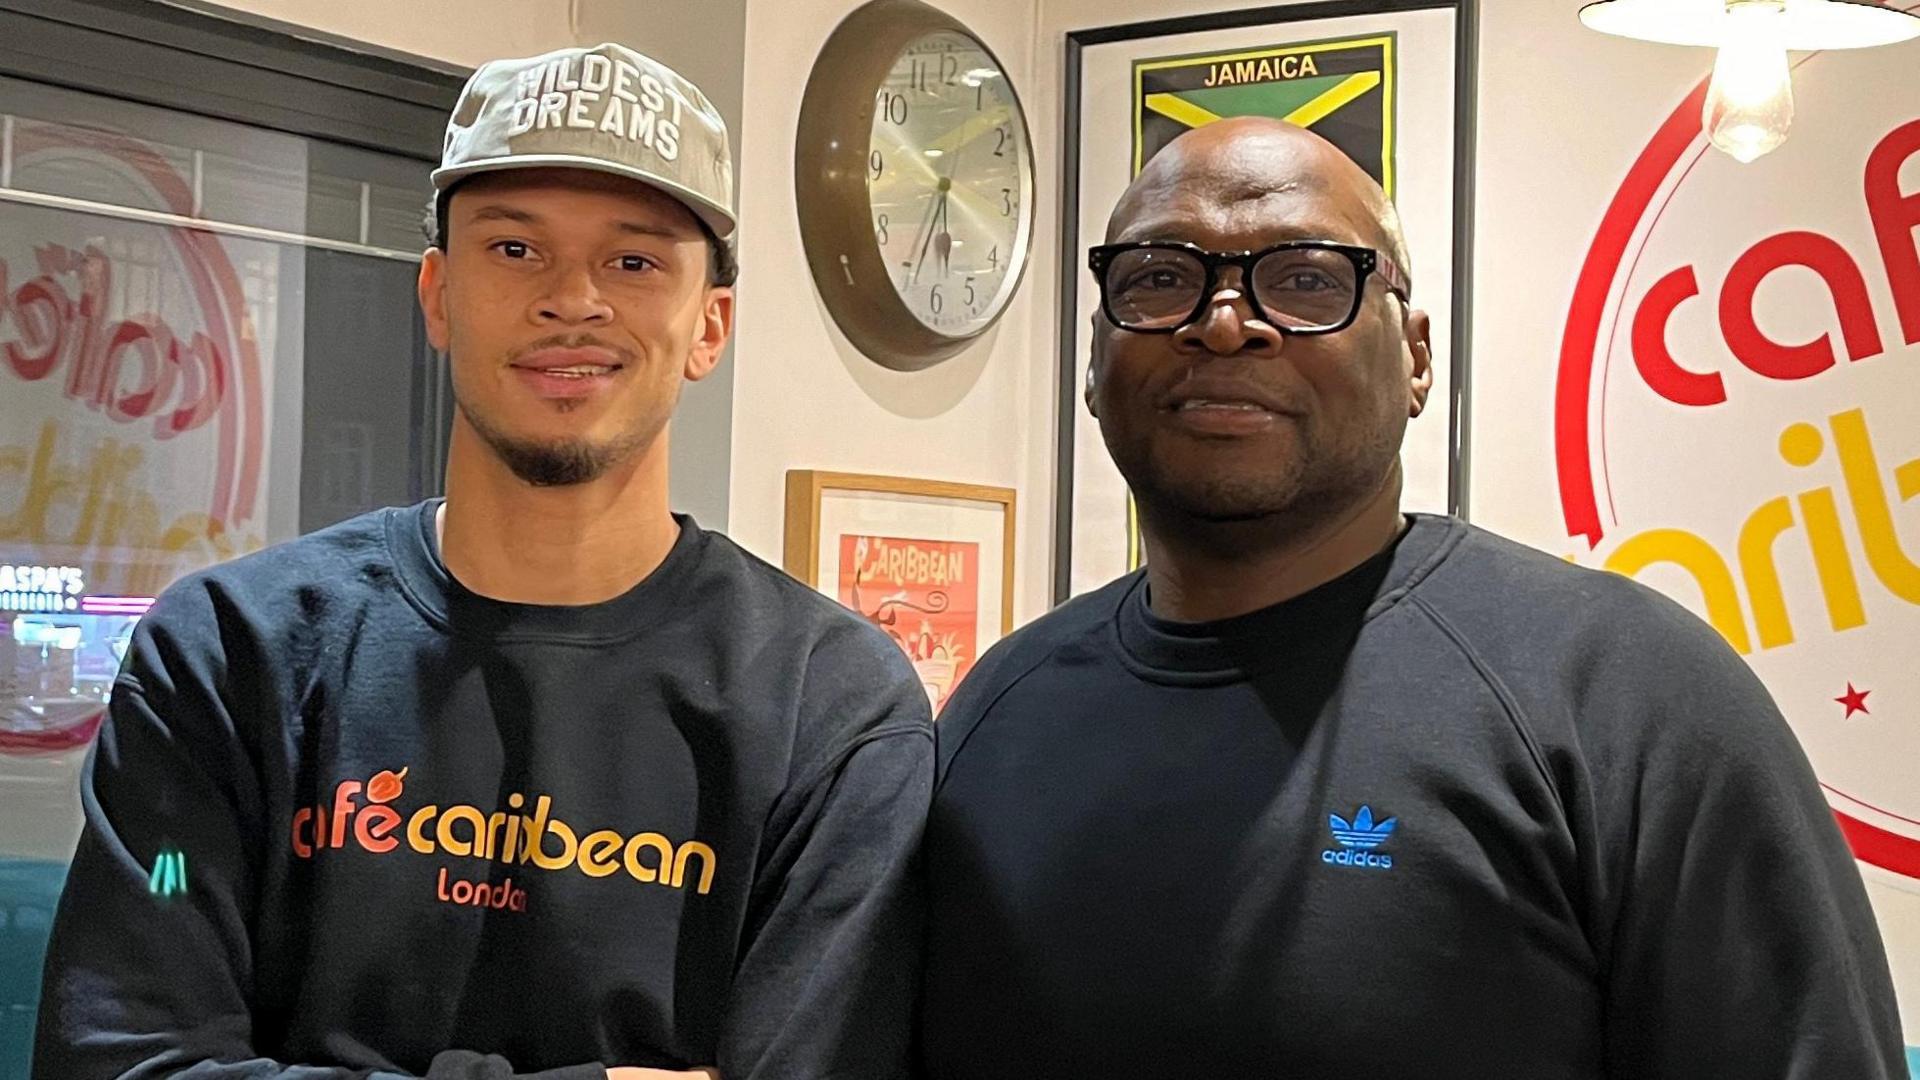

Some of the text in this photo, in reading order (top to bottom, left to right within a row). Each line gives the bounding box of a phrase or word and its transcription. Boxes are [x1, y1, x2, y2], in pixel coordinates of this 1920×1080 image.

[911, 59, 925, 92] 11
[939, 53, 957, 86] 12
[1204, 54, 1319, 87] JAMAICA
[884, 92, 907, 125] 10
[508, 91, 680, 161] DREAMS
[993, 127, 1004, 156] 2
[871, 150, 883, 181] 9
[1000, 188, 1011, 217] 3
[877, 213, 889, 246] 8
[987, 245, 998, 273] 4
[930, 284, 942, 315] 6
[963, 277, 975, 306] 5
[854, 536, 964, 587] CARIBBEAN
[1322, 849, 1392, 869] adidas
